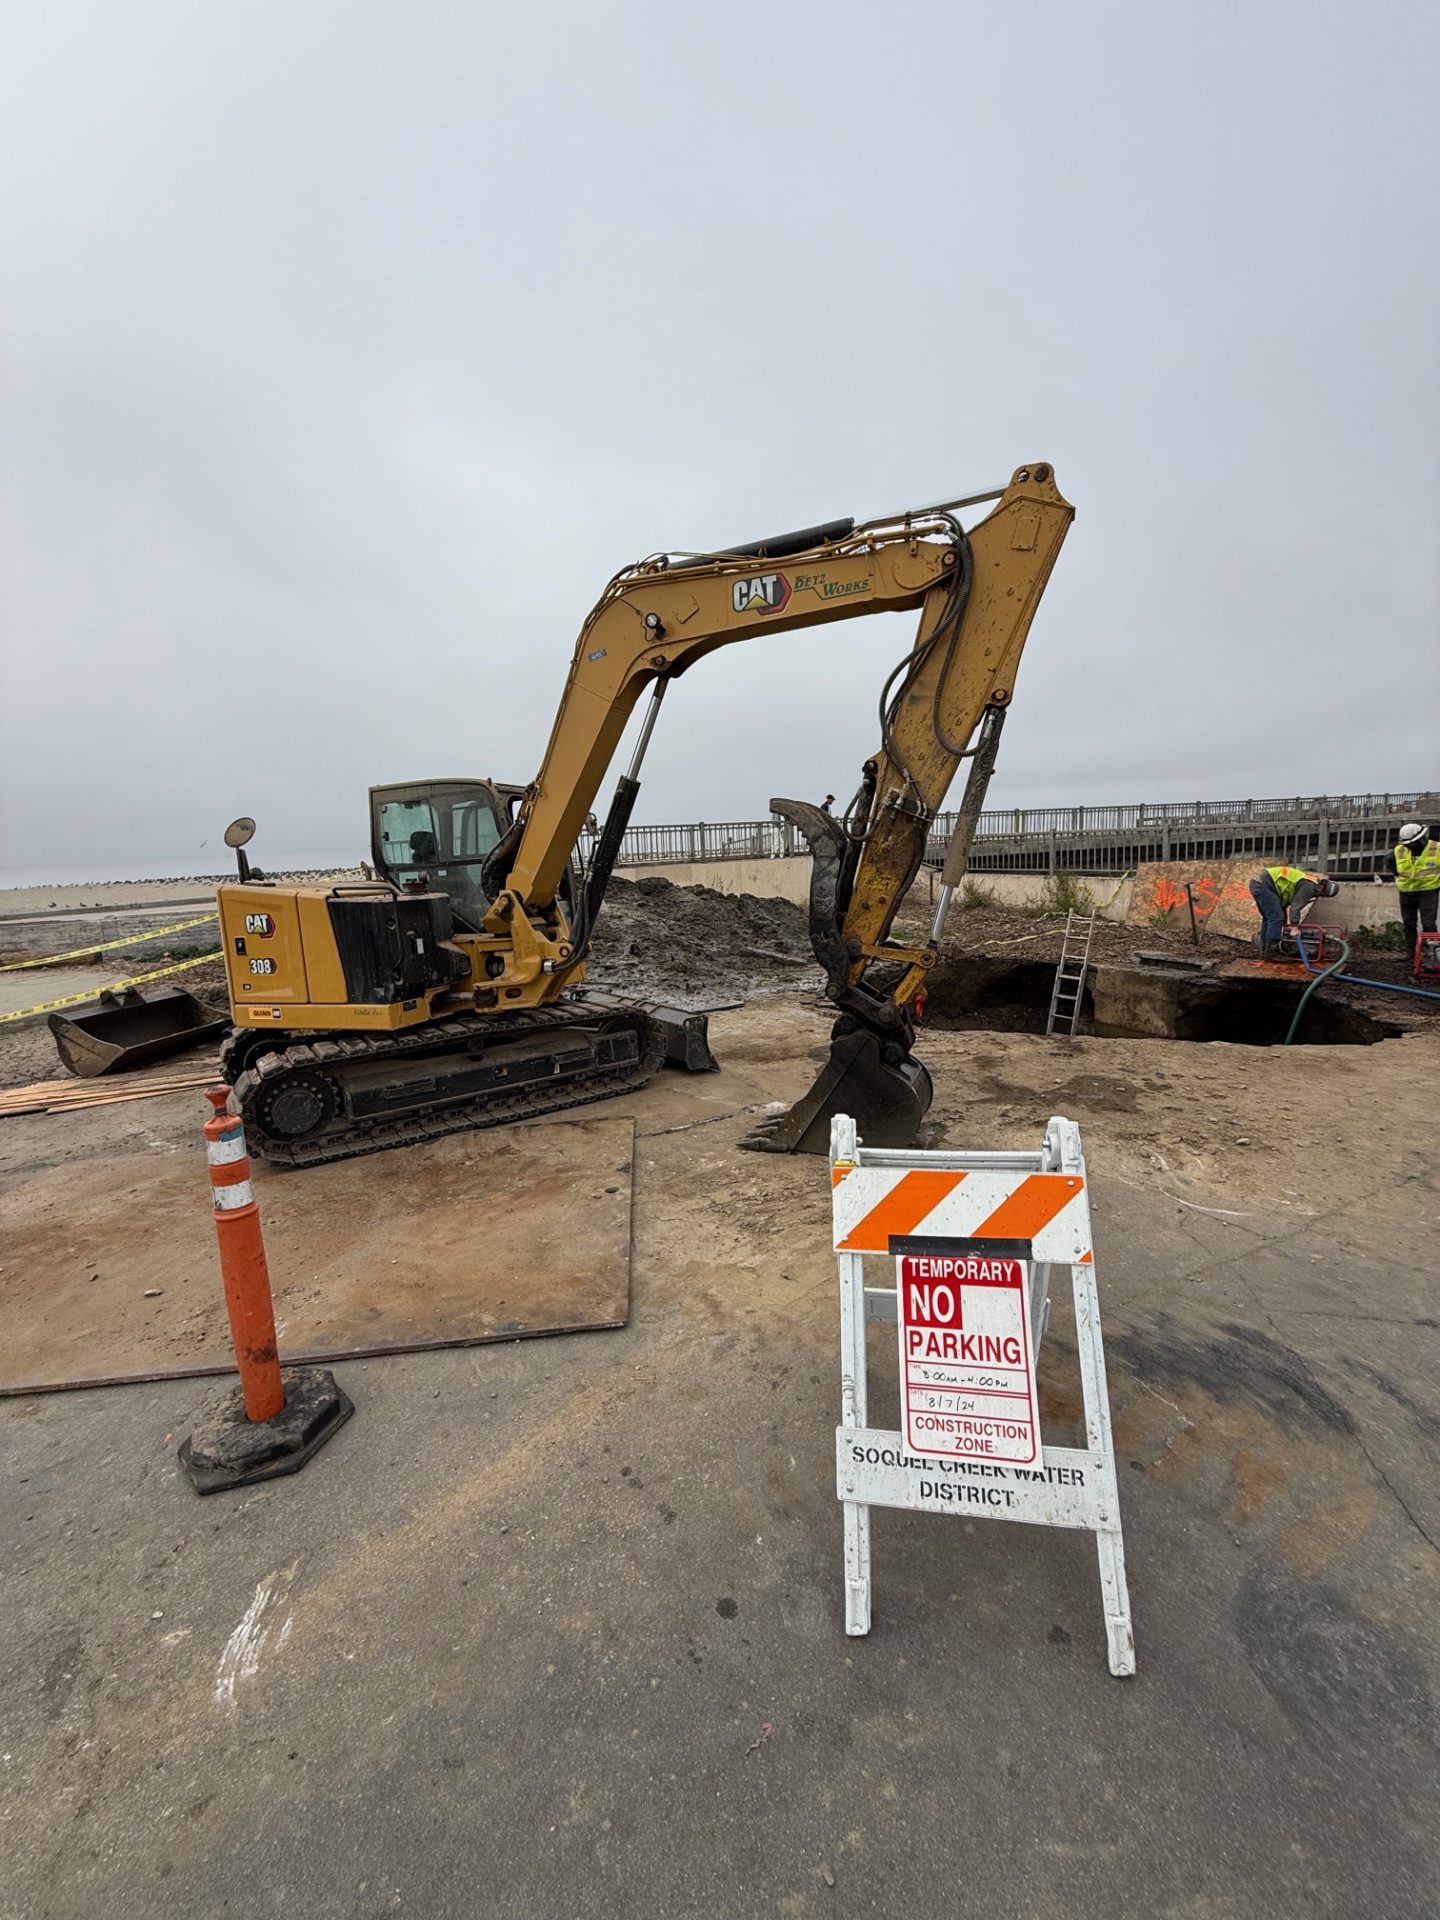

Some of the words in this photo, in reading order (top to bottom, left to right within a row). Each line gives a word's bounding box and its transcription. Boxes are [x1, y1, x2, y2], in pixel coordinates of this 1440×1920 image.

[733, 574, 777, 612] CAT
[823, 579, 869, 597] WORKS
[245, 914, 268, 934] CAT
[250, 959, 272, 974] 308
[908, 1258, 1014, 1282] TEMPORARY
[910, 1284, 955, 1323] NO
[909, 1330, 1021, 1364] PARKING
[915, 1416, 1028, 1440] CONSTRUCTION
[954, 1437, 994, 1453] ZONE
[852, 1446, 934, 1471] SOQUEL
[920, 1481, 1015, 1507] DISTRICT
